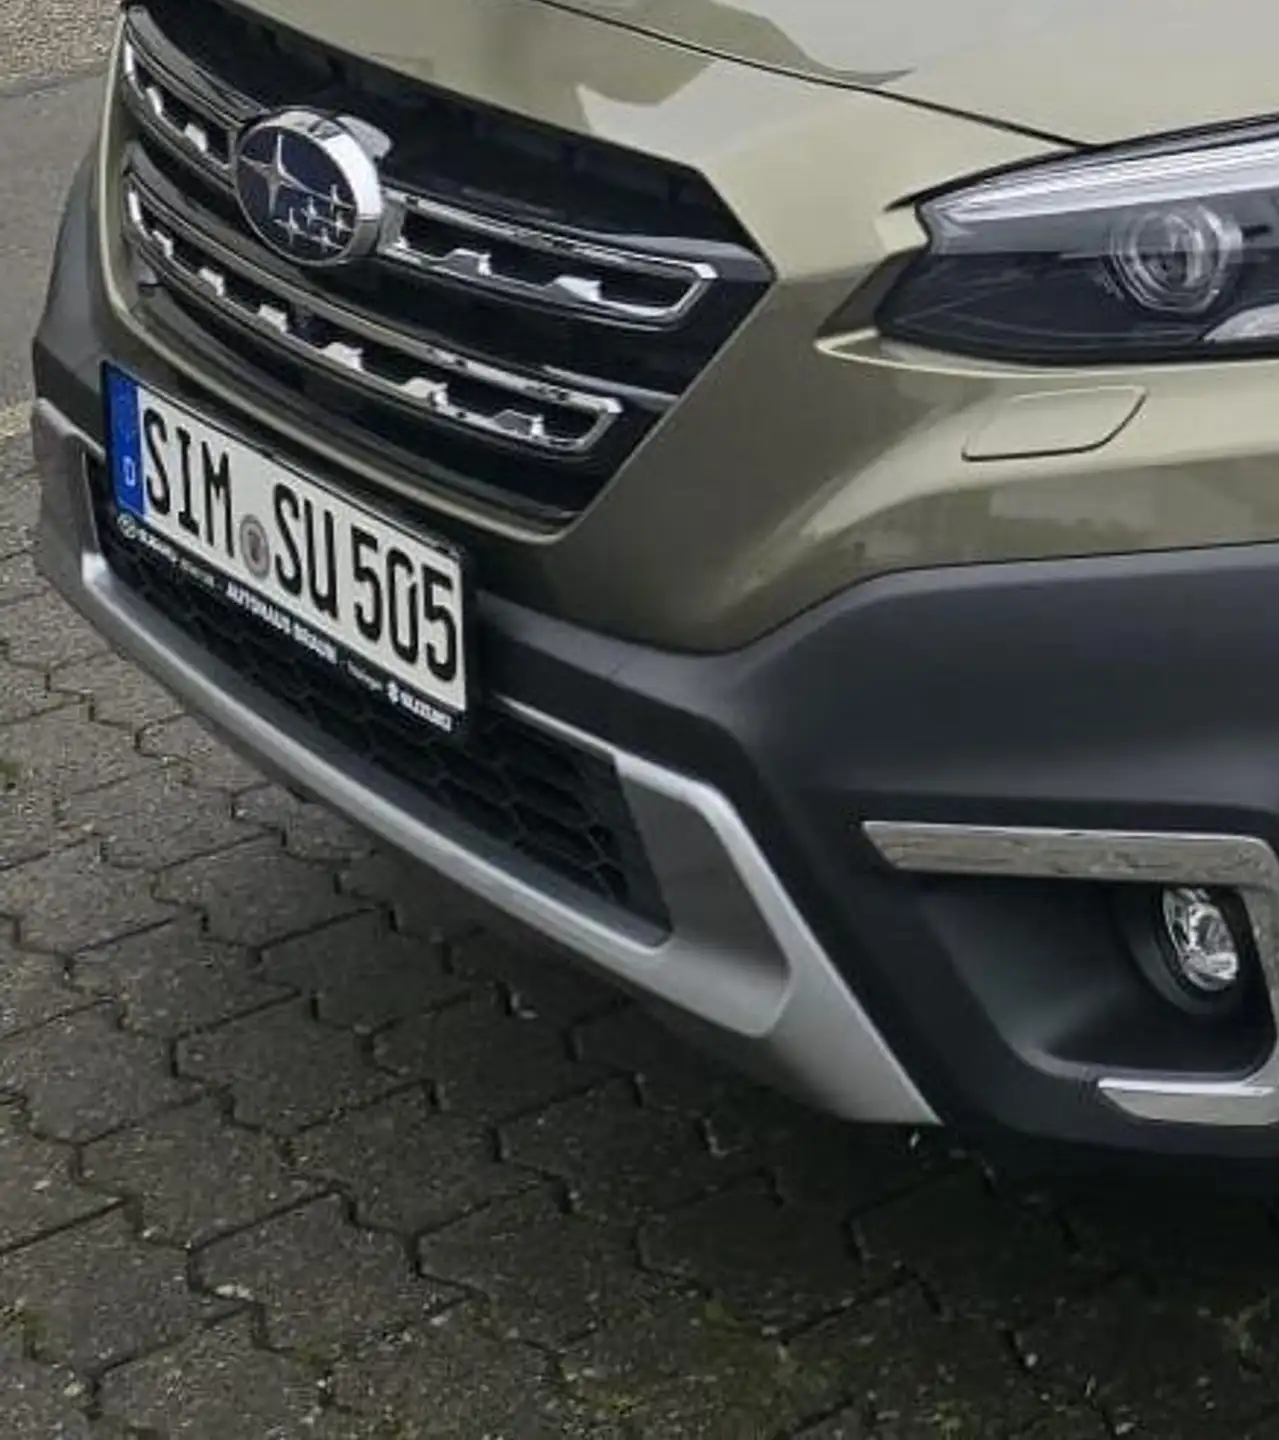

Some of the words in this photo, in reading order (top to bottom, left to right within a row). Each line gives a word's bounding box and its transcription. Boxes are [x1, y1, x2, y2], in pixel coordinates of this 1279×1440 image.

[124, 455, 136, 488] D
[143, 407, 235, 558] SIM
[273, 483, 338, 622] SU
[350, 525, 458, 682] 505
